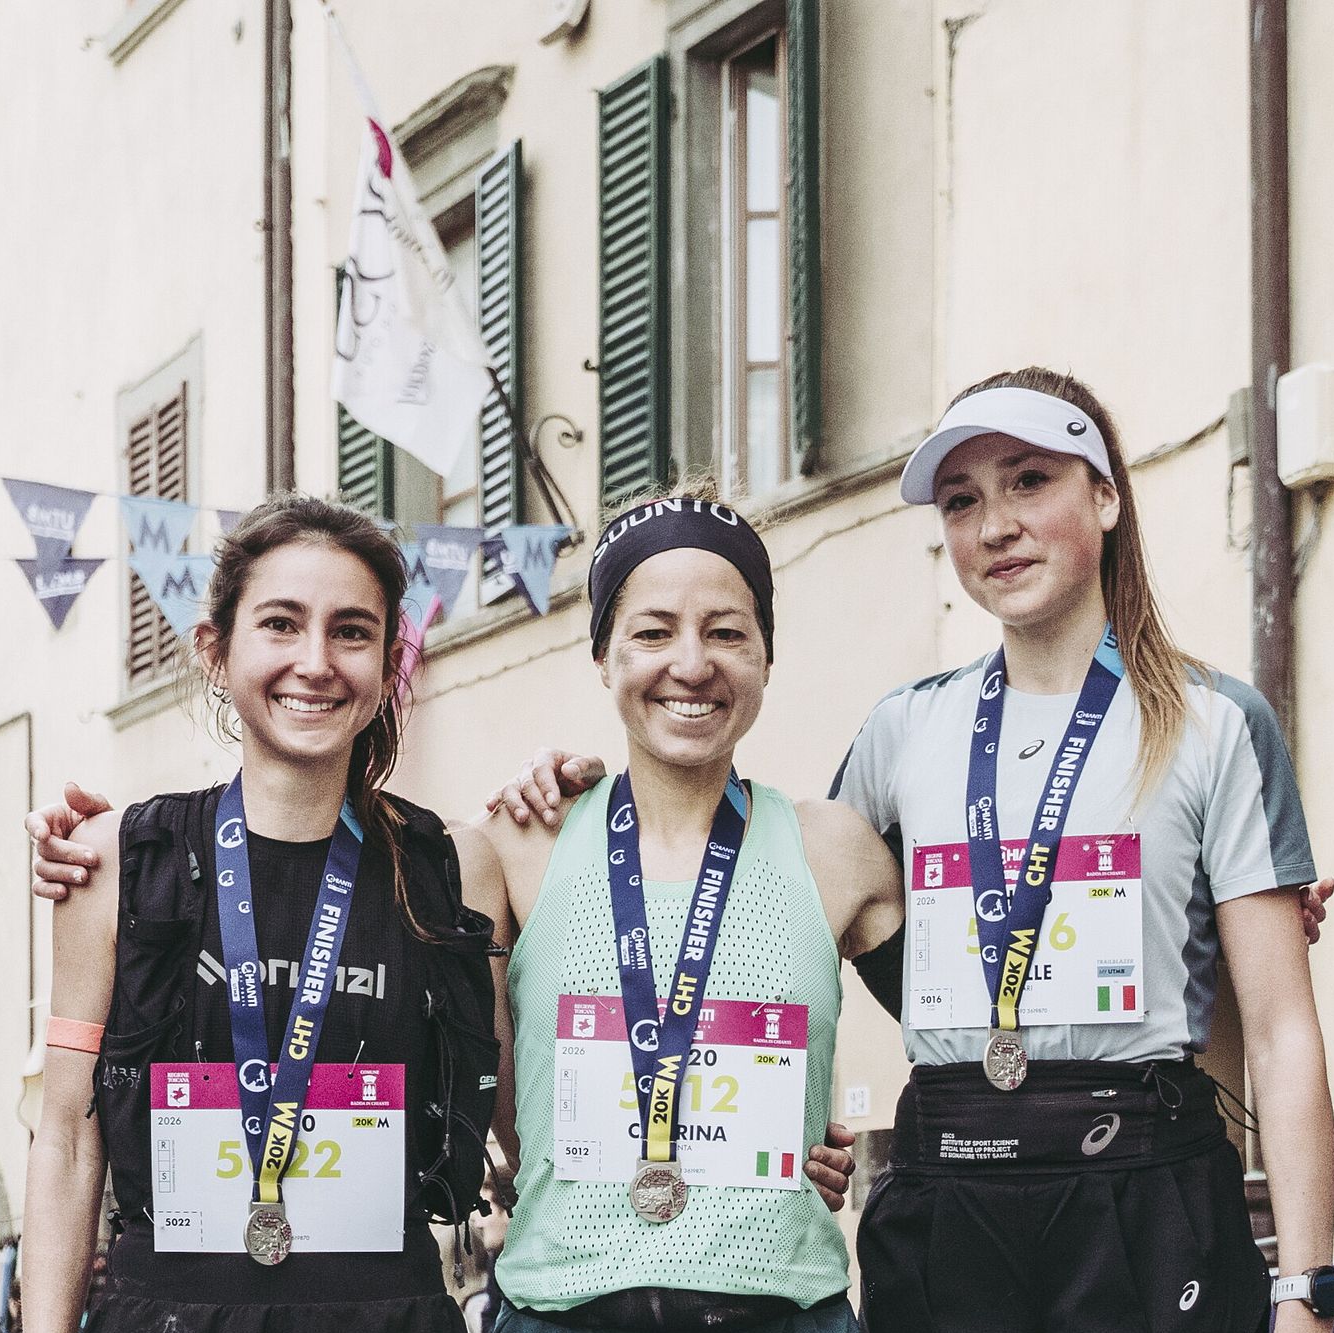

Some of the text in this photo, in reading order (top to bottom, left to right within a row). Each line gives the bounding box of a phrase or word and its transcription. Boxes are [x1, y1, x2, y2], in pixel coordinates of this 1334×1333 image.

[594, 498, 738, 564] SUUNTO
[1038, 736, 1087, 832] FINISHER
[1025, 843, 1050, 887] CHT
[917, 897, 936, 905] 2026
[1092, 888, 1109, 897] 20K
[684, 868, 724, 961] FINISHER
[967, 912, 1076, 955] 56
[301, 903, 341, 1005] FINISHER
[672, 973, 698, 1015] CHT
[1004, 961, 1022, 997] 20K
[920, 995, 942, 1004] 5016
[288, 1016, 314, 1060] CHT
[562, 1046, 585, 1055] 2026
[757, 1055, 774, 1063] 20K
[619, 1072, 739, 1113] 512
[653, 1089, 670, 1124] 20K
[158, 1117, 181, 1125] 2026
[356, 1118, 373, 1126] 20K
[628, 1123, 727, 1142] CRINA
[161, 1141, 166, 1149] R
[216, 1140, 342, 1178] 522
[267, 1132, 287, 1169] 20K
[566, 1147, 589, 1156] 5012
[162, 1172, 166, 1180] S
[165, 1218, 191, 1226] 5022
